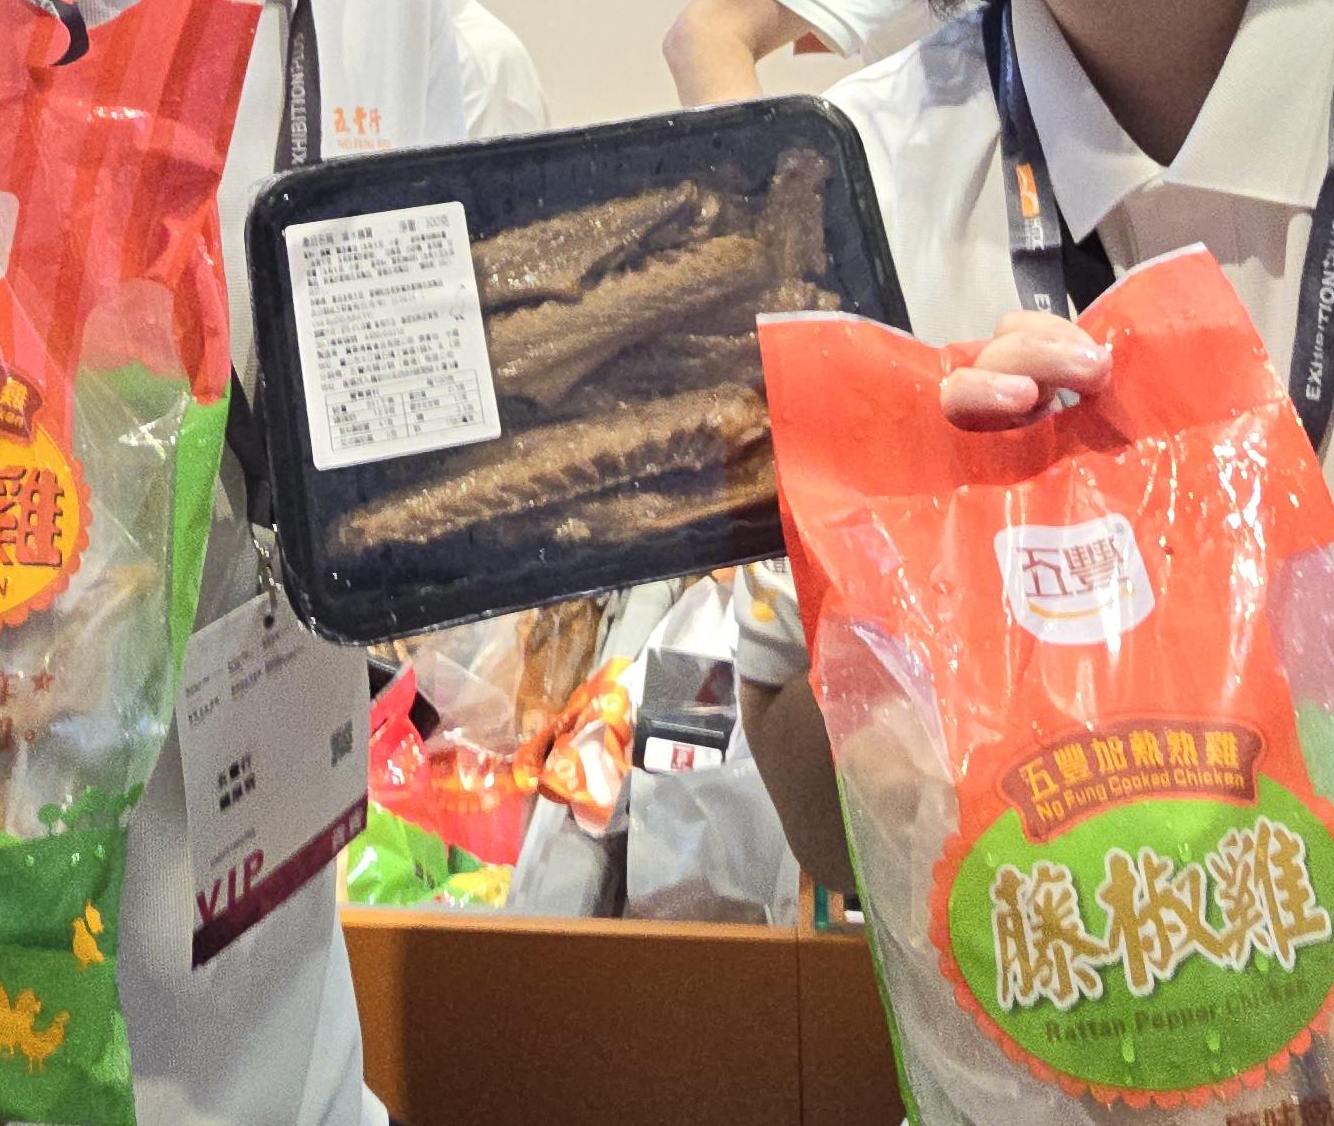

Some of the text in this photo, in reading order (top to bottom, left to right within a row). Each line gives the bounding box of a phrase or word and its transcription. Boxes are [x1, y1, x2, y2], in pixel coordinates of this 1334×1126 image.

[1035, 768, 1244, 823] Ng Fung Cooked Chicken
[196, 849, 265, 923] VIP
[992, 820, 1331, 1010] 藤椒雞
